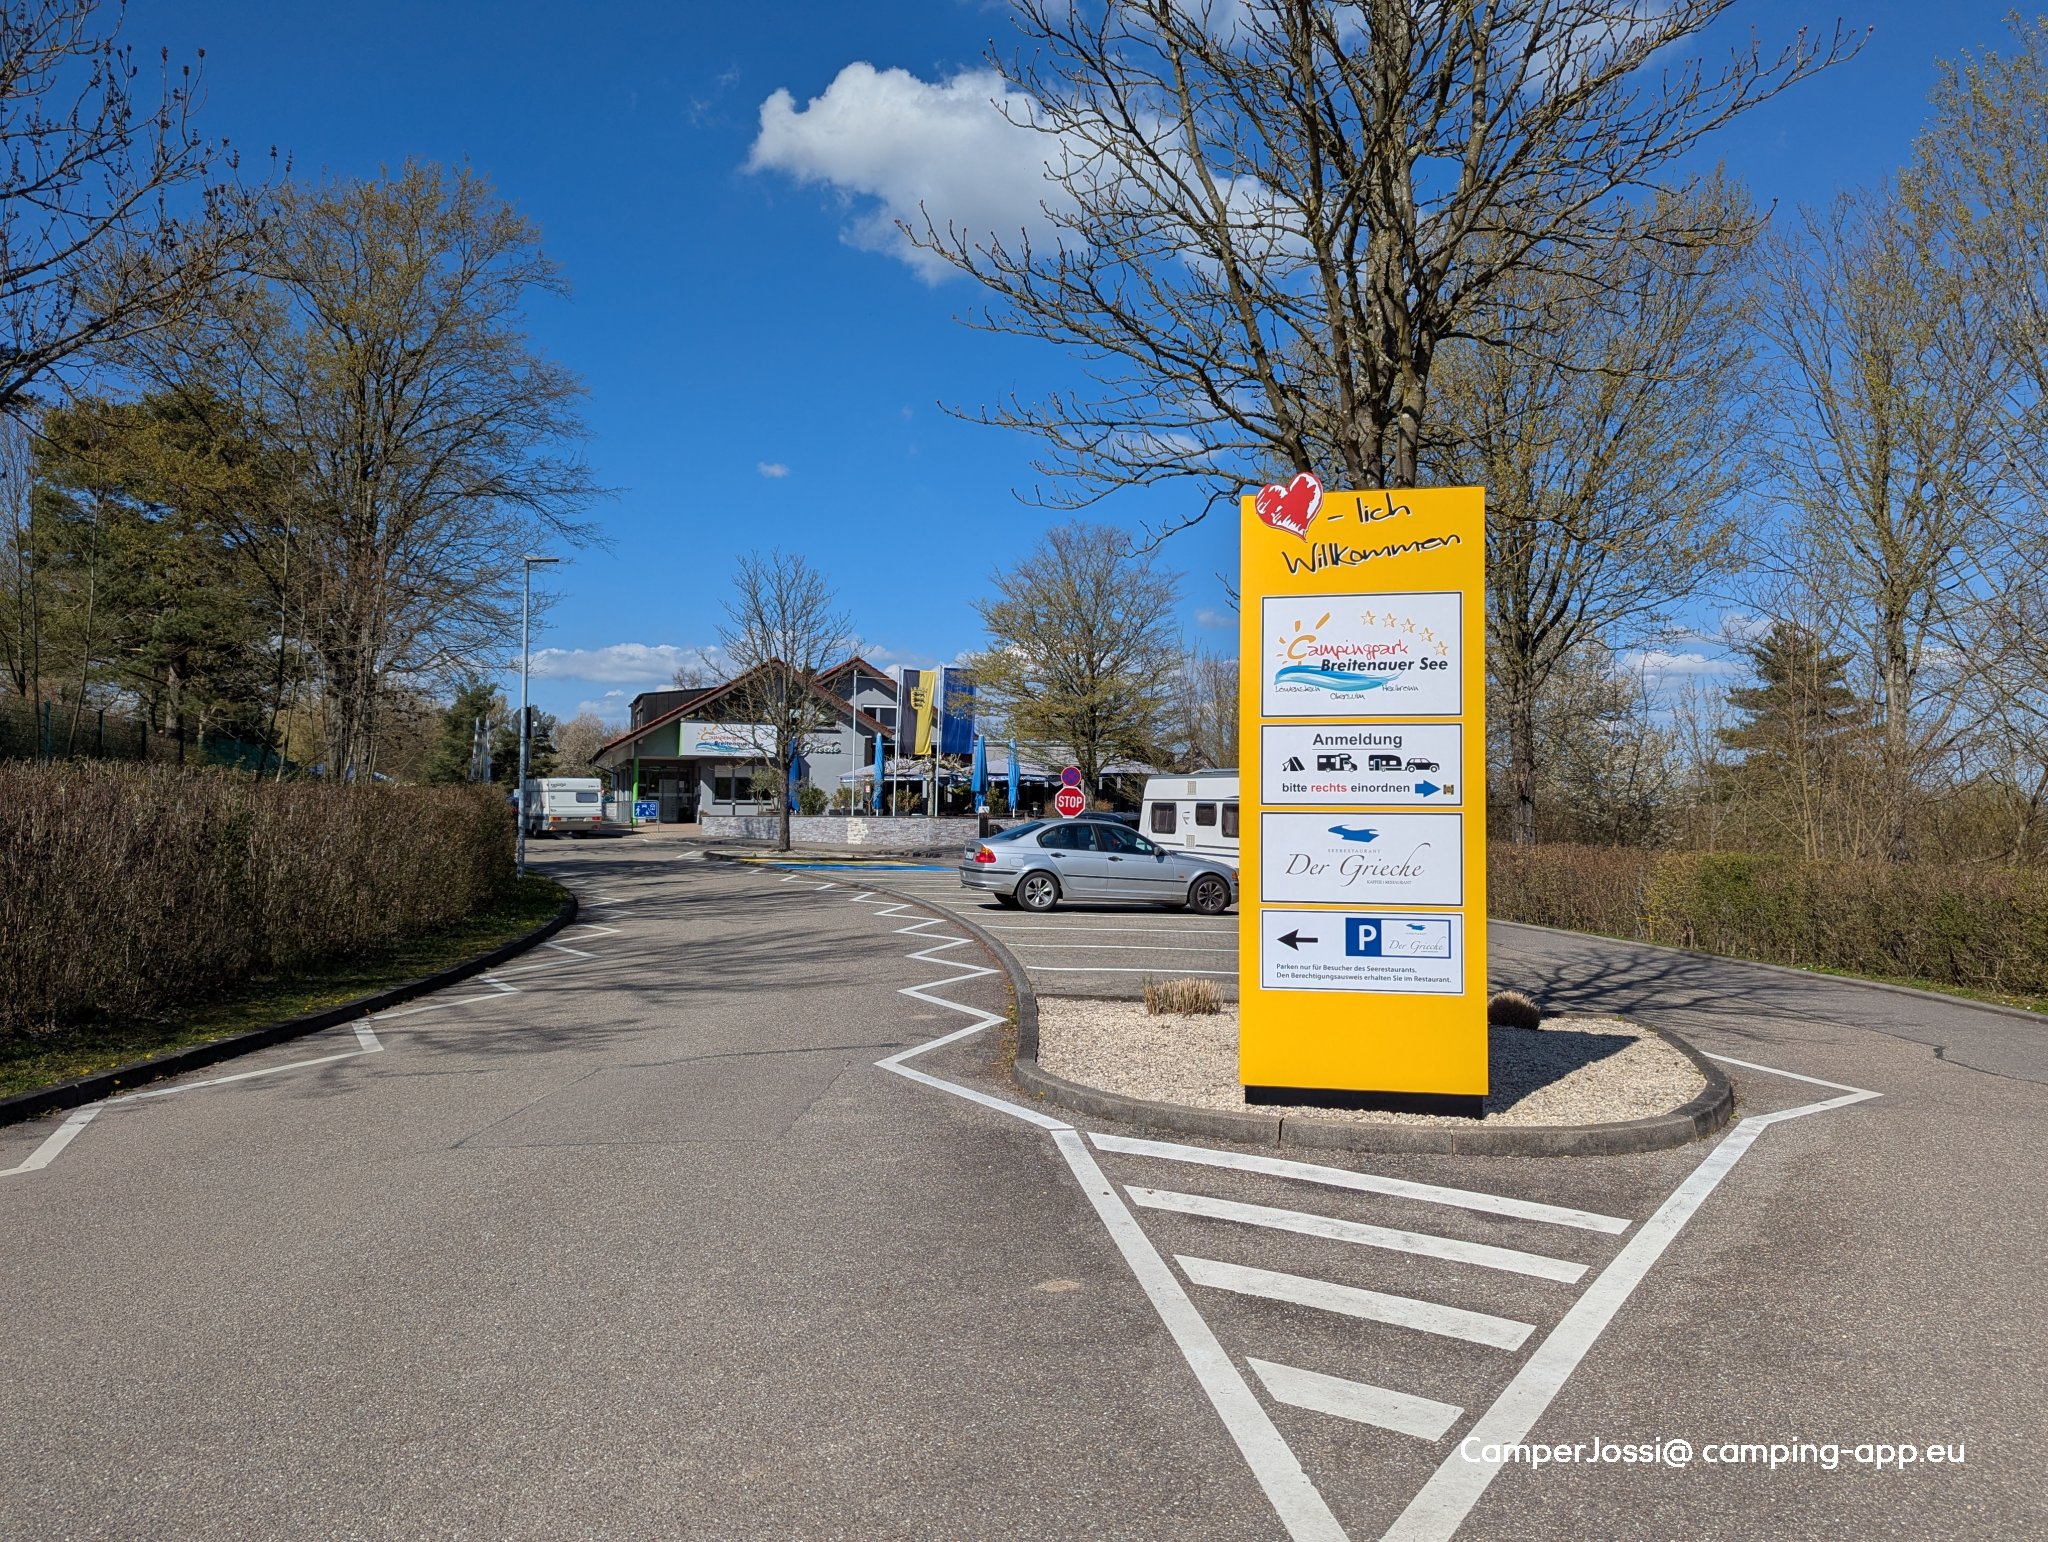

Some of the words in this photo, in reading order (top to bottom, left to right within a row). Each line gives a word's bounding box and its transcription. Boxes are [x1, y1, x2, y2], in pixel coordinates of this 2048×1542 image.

[1356, 493, 1412, 523] lich
[1282, 534, 1462, 575] Willkommen
[1287, 634, 1409, 660] Campingpark
[1321, 659, 1416, 672] Breitenauer
[1419, 657, 1449, 671] See
[1312, 733, 1403, 748] Anmeldung
[1282, 783, 1308, 793] bitte
[1310, 783, 1348, 793] rechts
[1350, 783, 1410, 793] einordnen
[1058, 795, 1083, 808] STOP
[1285, 853, 1330, 876] Der
[1339, 842, 1431, 888] Grieche
[1358, 924, 1377, 951] P
[1388, 939, 1407, 950] Der
[1410, 936, 1447, 954] Grieche
[1276, 963, 1299, 971] Parken
[1322, 964, 1353, 972] Besucher
[1366, 965, 1417, 973] Seerestaurants.
[1290, 972, 1363, 981] Berechtigungsausweis
[1392, 974, 1403, 982] Sie
[1413, 975, 1452, 983] Restaurant.
